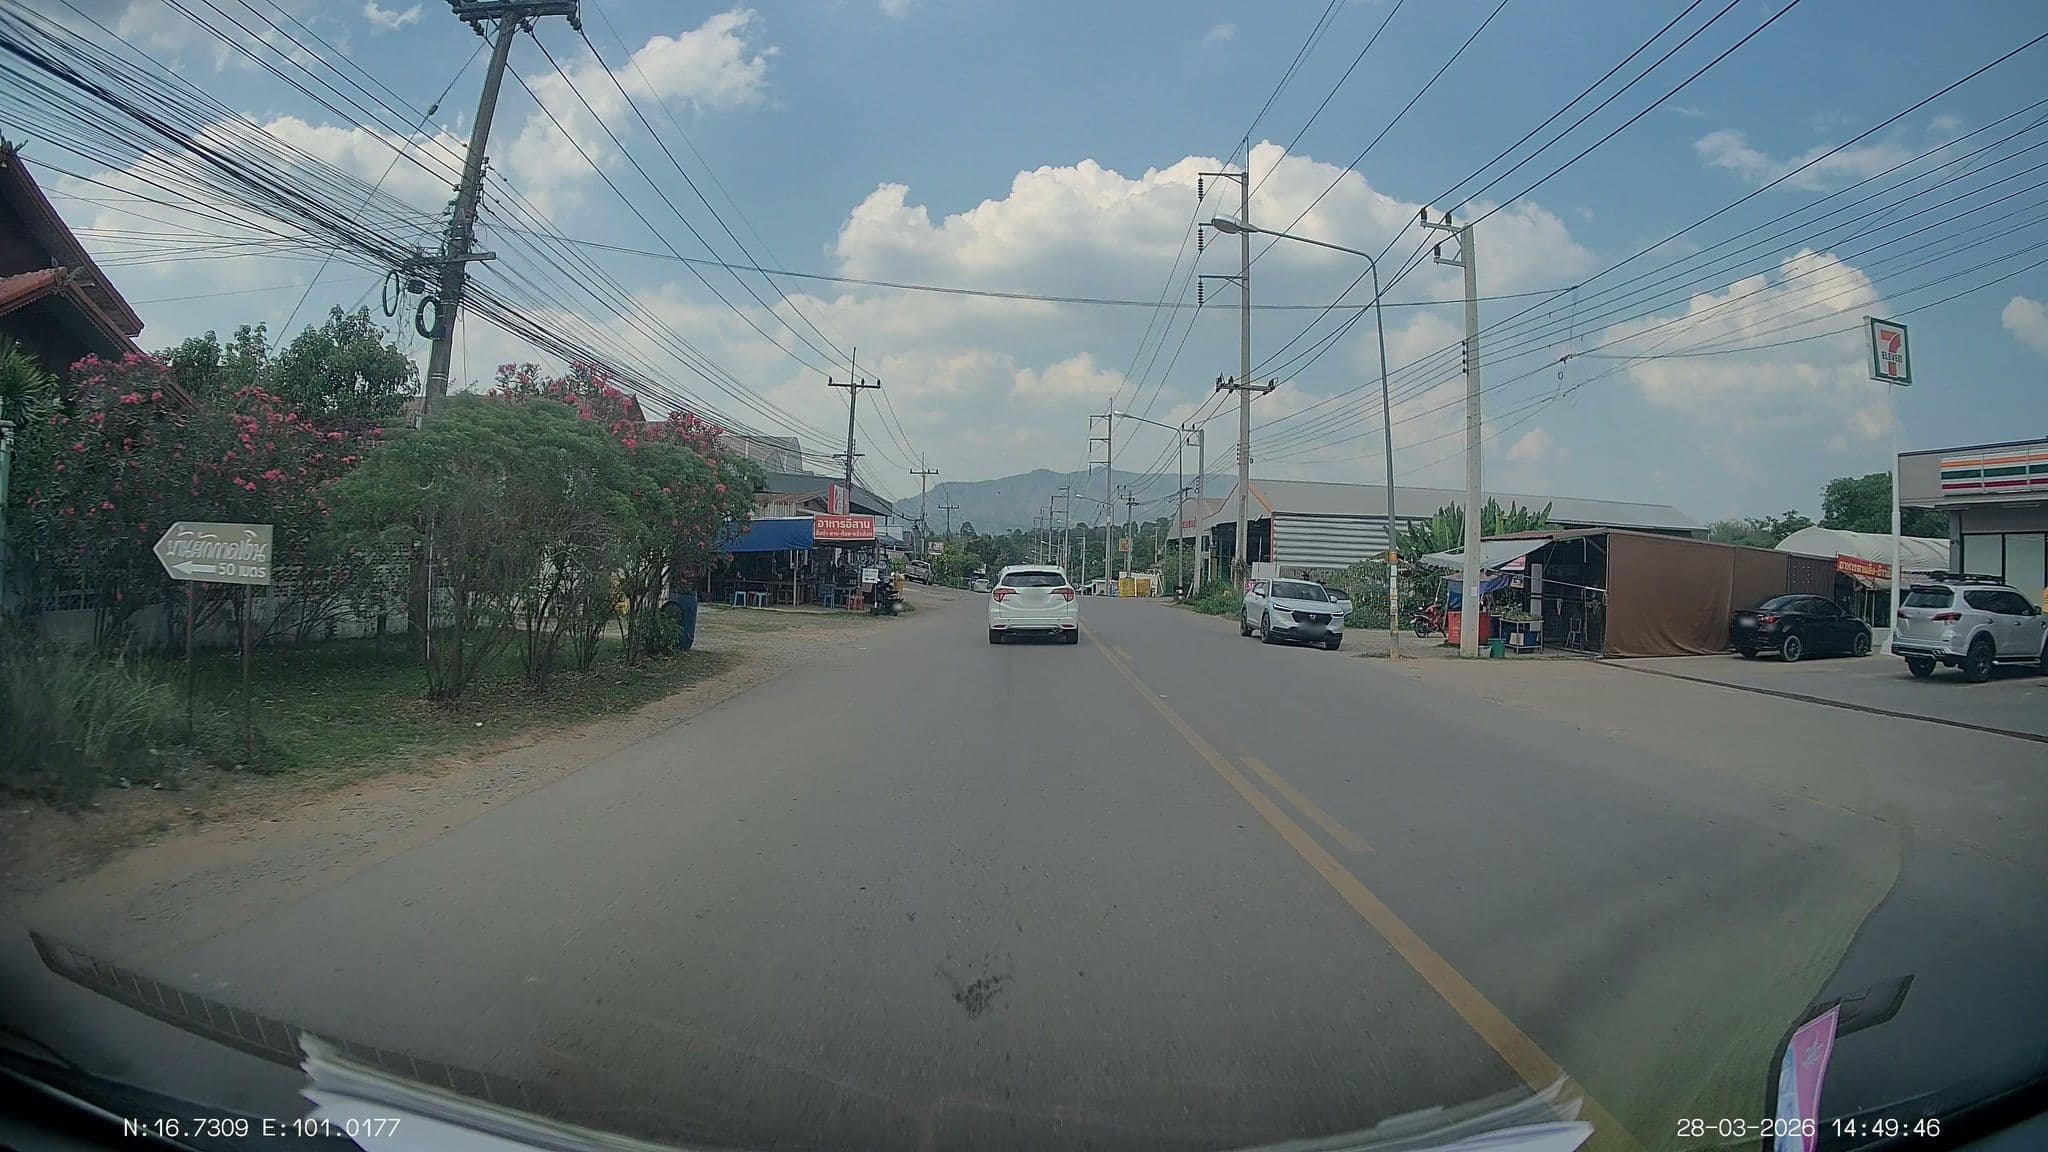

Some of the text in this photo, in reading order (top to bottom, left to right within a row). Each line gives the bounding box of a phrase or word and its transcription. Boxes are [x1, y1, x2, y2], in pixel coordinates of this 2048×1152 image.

[817, 517, 870, 529] อาหารอีสาน
[218, 562, 267, 578] 50 เมตร
